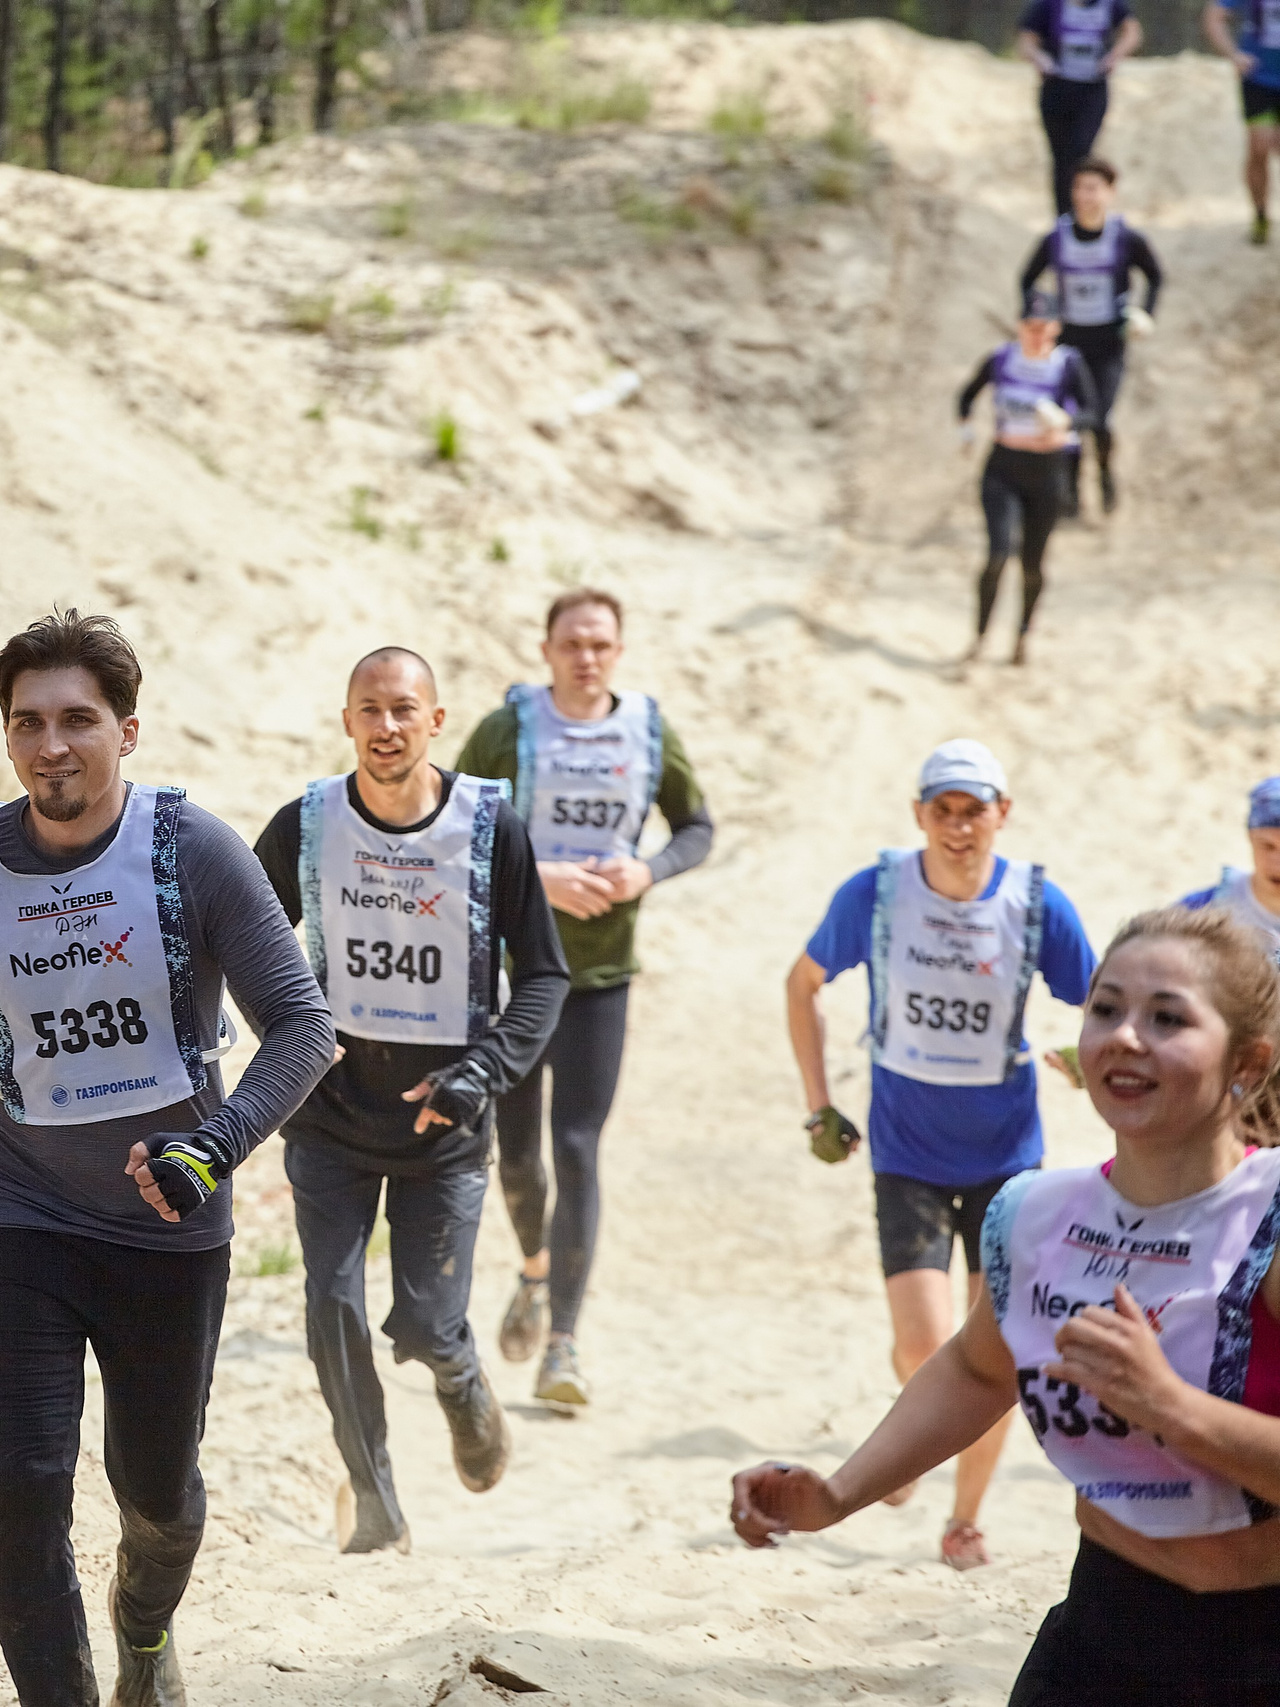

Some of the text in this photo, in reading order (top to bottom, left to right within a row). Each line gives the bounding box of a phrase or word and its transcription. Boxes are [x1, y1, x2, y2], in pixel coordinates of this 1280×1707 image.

[552, 797, 628, 829] 5337
[355, 850, 435, 867] ГОНКА ГЕРОЕВ
[18, 890, 114, 918] ГОНКА ГЕРОЕВ
[346, 937, 442, 984] 5340
[906, 991, 991, 1034] 5339
[30, 997, 149, 1059] 5338
[75, 1075, 159, 1101] ГАЗПРОМБАНК
[1118, 1236, 1192, 1257] ГЕРОЕВ
